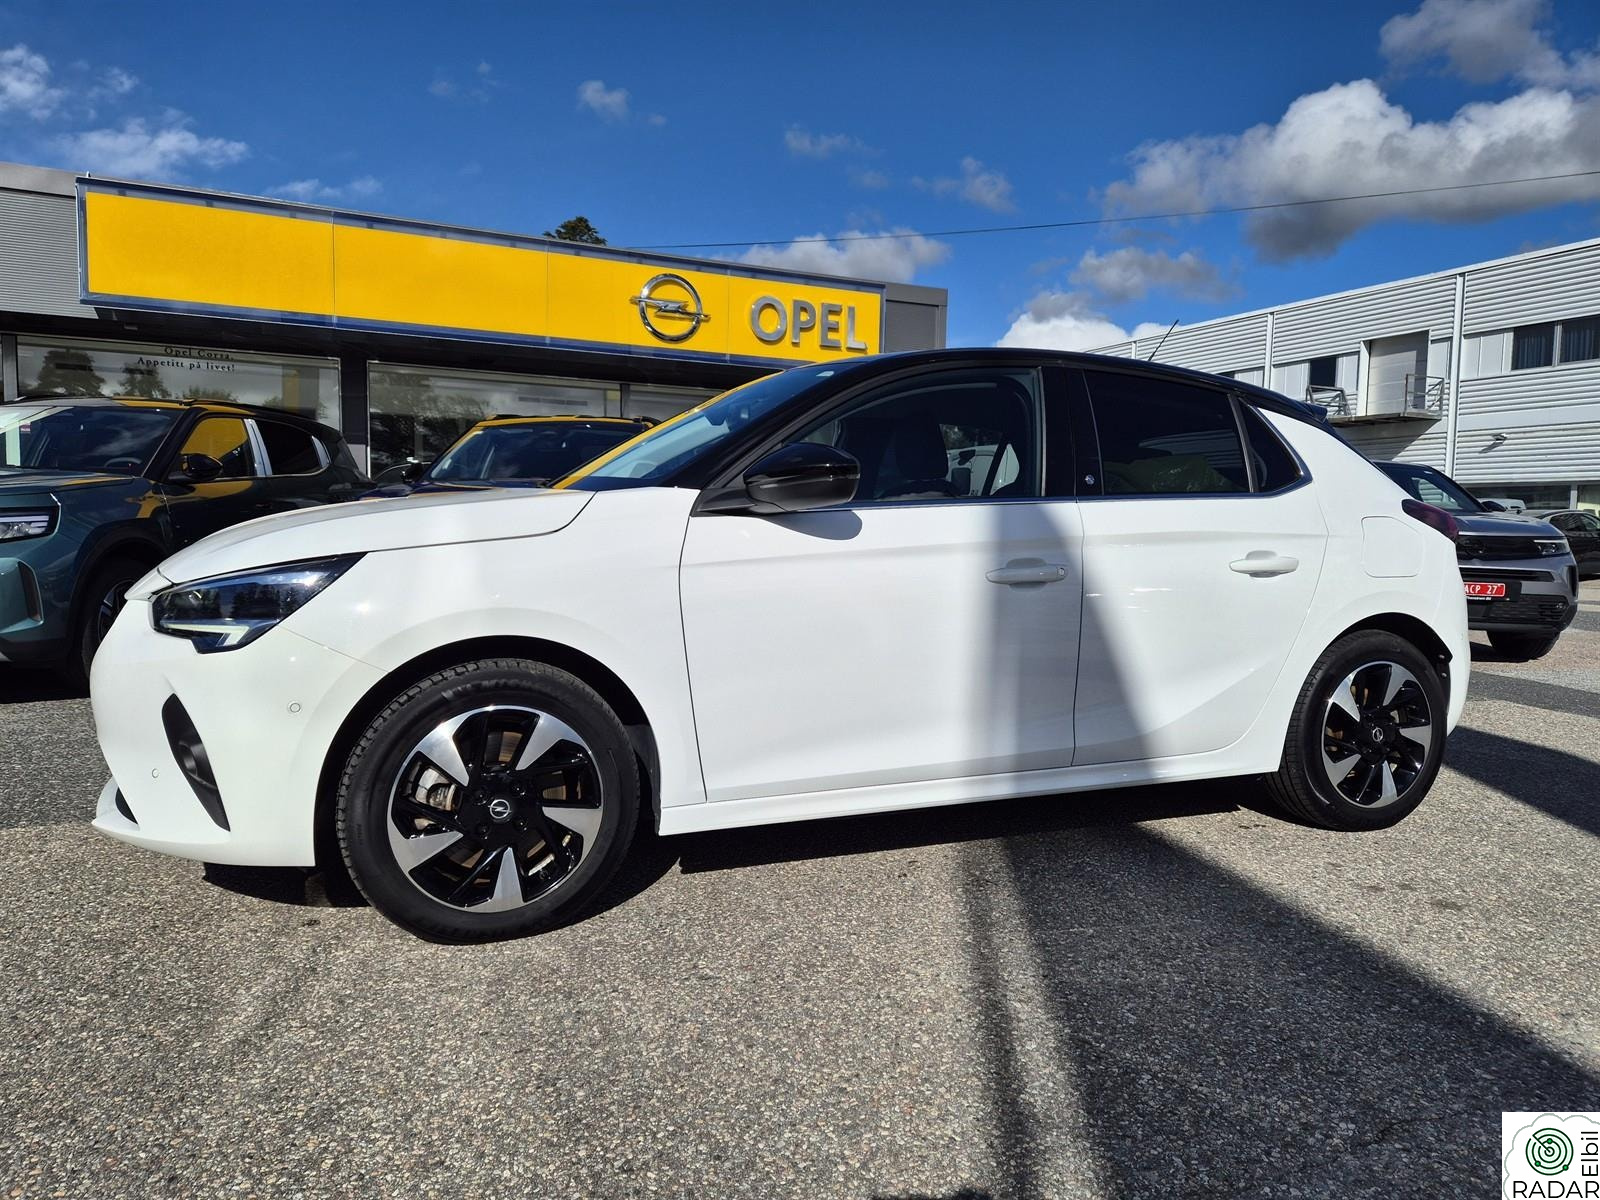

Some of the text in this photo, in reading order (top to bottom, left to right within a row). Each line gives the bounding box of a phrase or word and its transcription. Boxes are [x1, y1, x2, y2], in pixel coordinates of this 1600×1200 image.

[750, 295, 867, 351] OPEL
[164, 346, 192, 357] Opel
[137, 356, 235, 372] Appetitt på livet!
[1464, 584, 1498, 595] ACP 27
